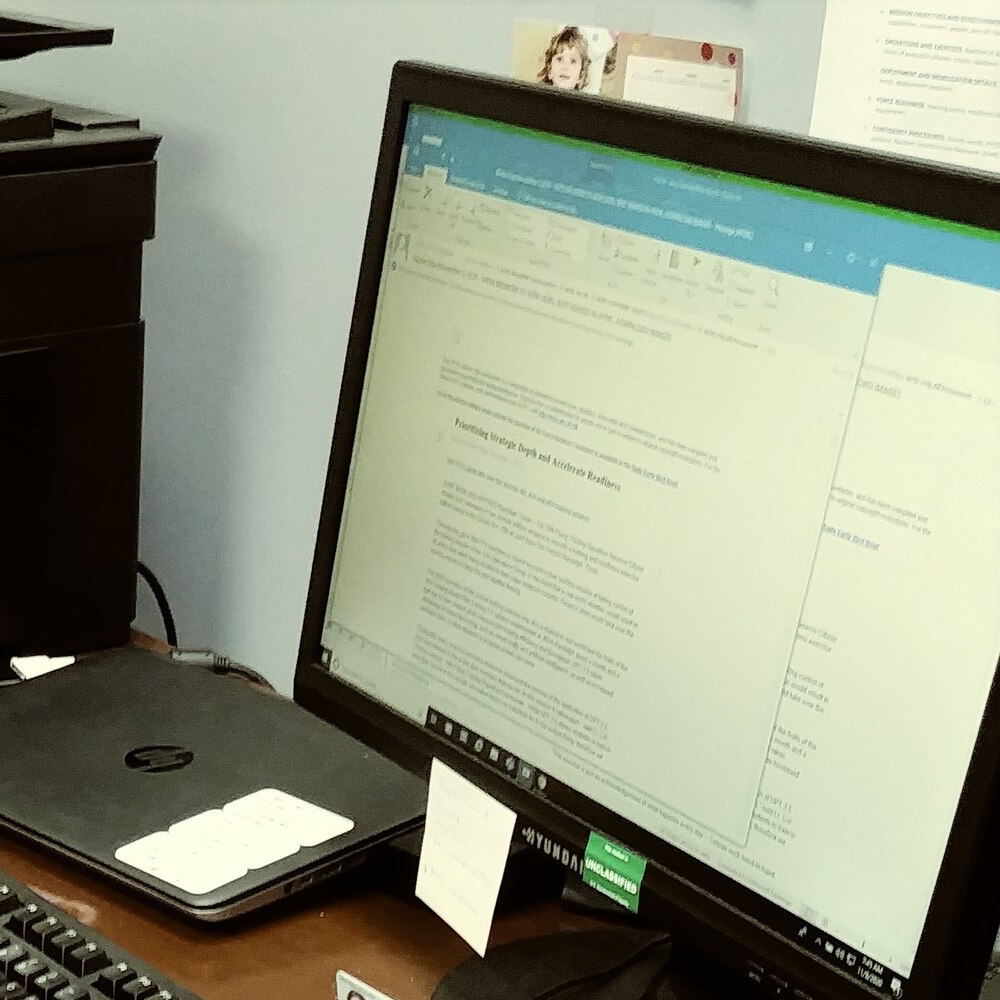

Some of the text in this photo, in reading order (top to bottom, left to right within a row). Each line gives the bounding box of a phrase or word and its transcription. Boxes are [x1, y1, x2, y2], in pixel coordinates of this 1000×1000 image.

[489, 430, 516, 450] Strategic
[518, 443, 537, 460] Depth
[538, 452, 551, 463] and
[551, 457, 586, 480] Accelerate
[587, 470, 621, 492] Readiness
[522, 826, 583, 875] HYUNDAI
[585, 857, 638, 895] UNCLASSIFIED
